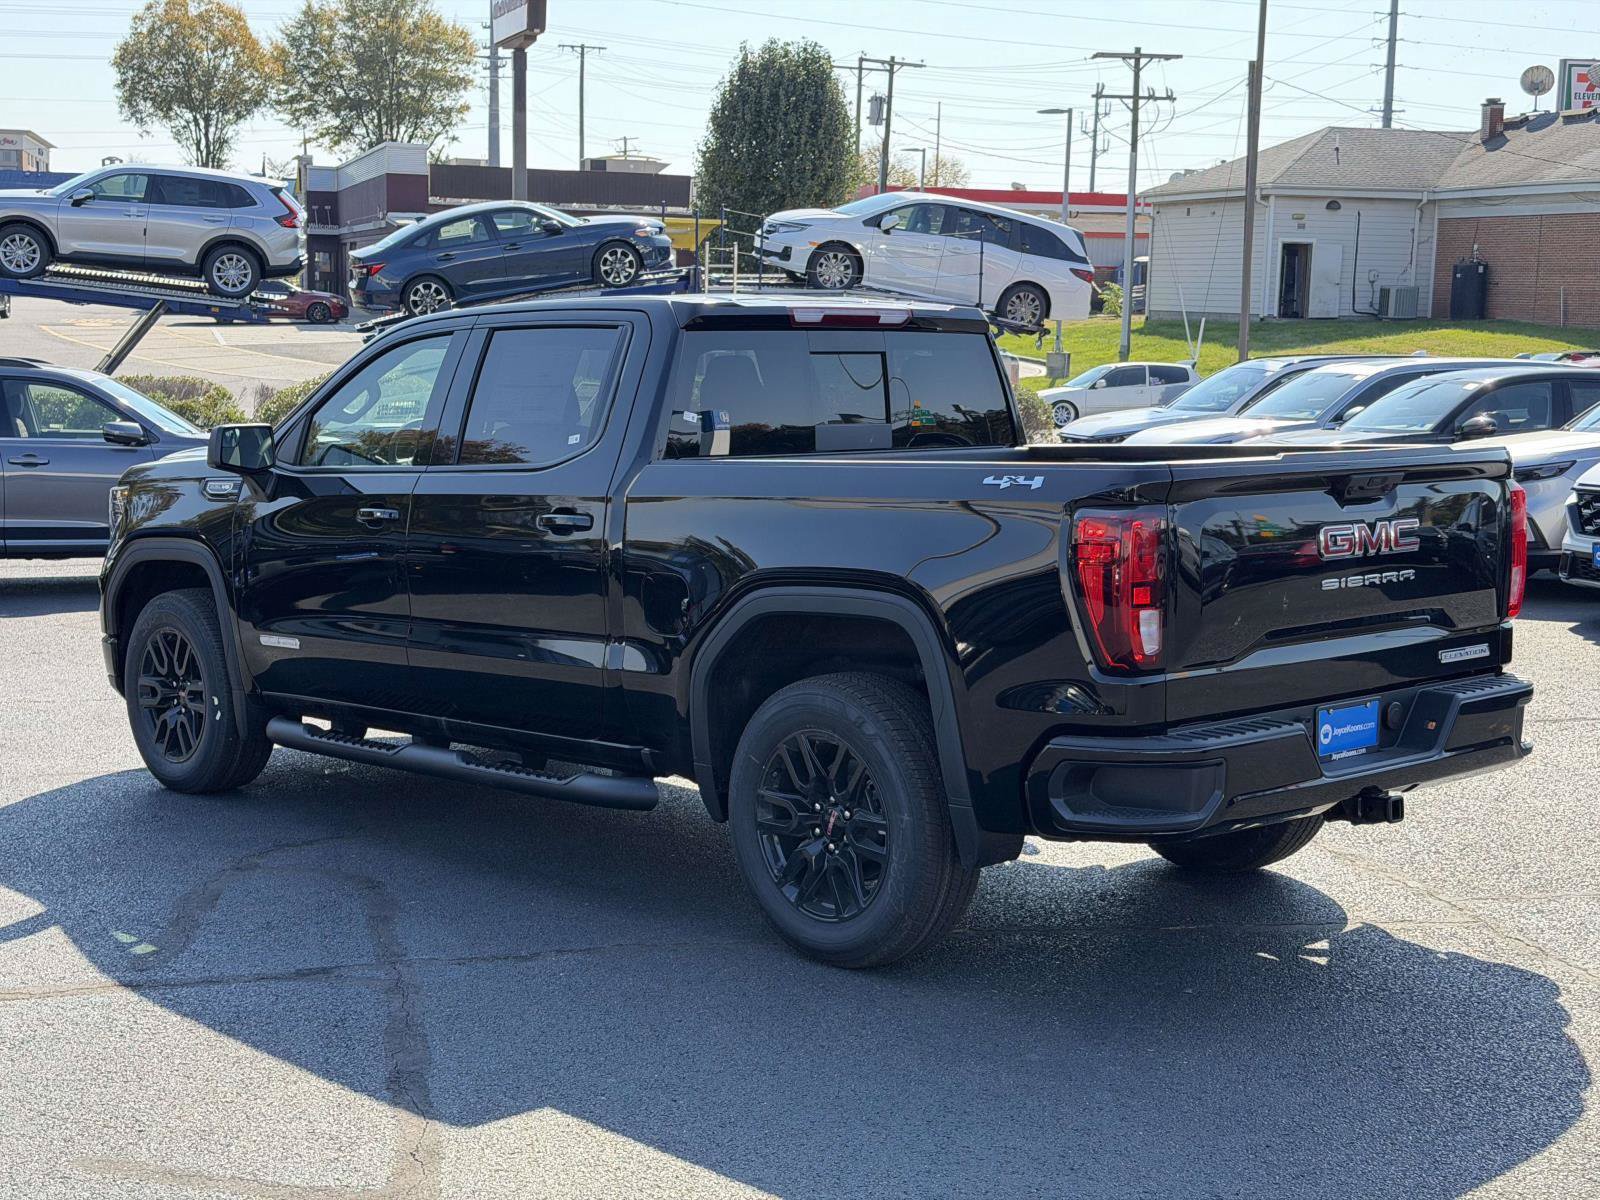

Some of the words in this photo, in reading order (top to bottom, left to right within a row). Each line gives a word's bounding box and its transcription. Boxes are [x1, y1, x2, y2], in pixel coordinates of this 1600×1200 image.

[1319, 518, 1420, 560] GMC
[1321, 569, 1416, 591] SIERRA
[1442, 646, 1488, 660] ELEVATION
[1332, 721, 1376, 736] JoyceKoons.com
